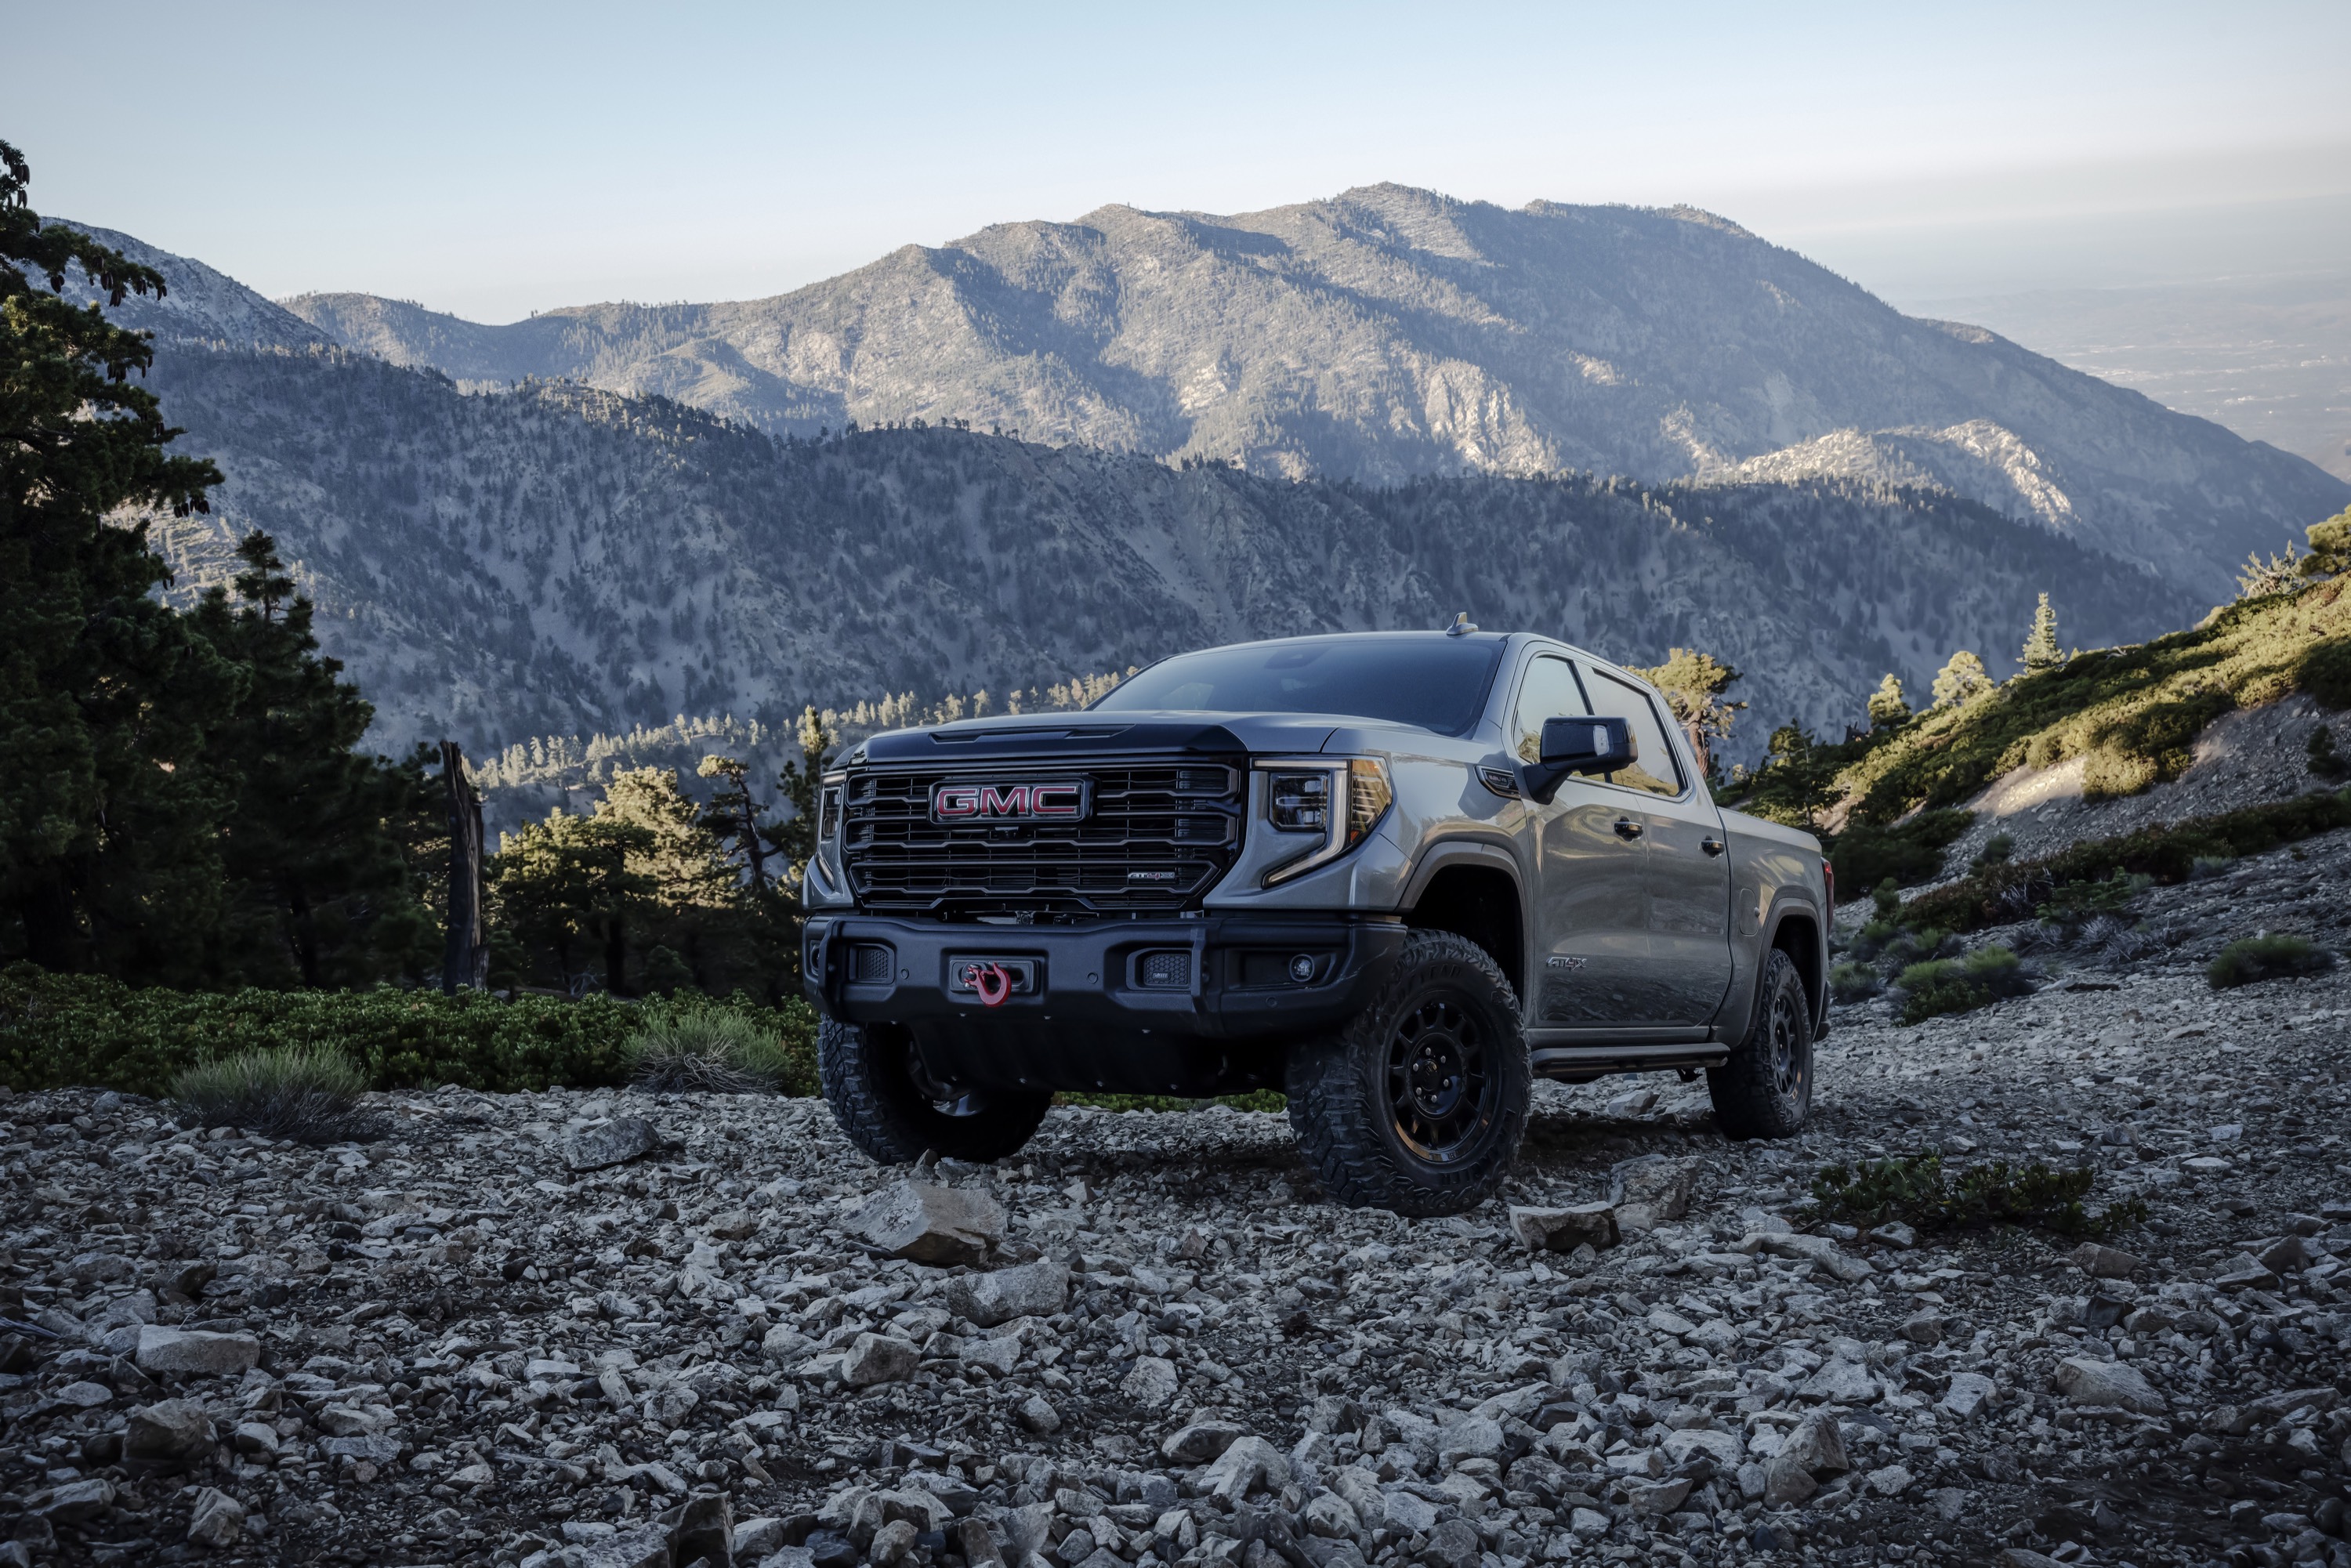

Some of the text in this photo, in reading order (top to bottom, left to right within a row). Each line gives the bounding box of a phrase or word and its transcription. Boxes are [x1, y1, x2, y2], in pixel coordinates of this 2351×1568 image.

[937, 786, 1080, 817] GMC
[1128, 871, 1175, 881] AT4X
[1545, 957, 1587, 971] AT4X
